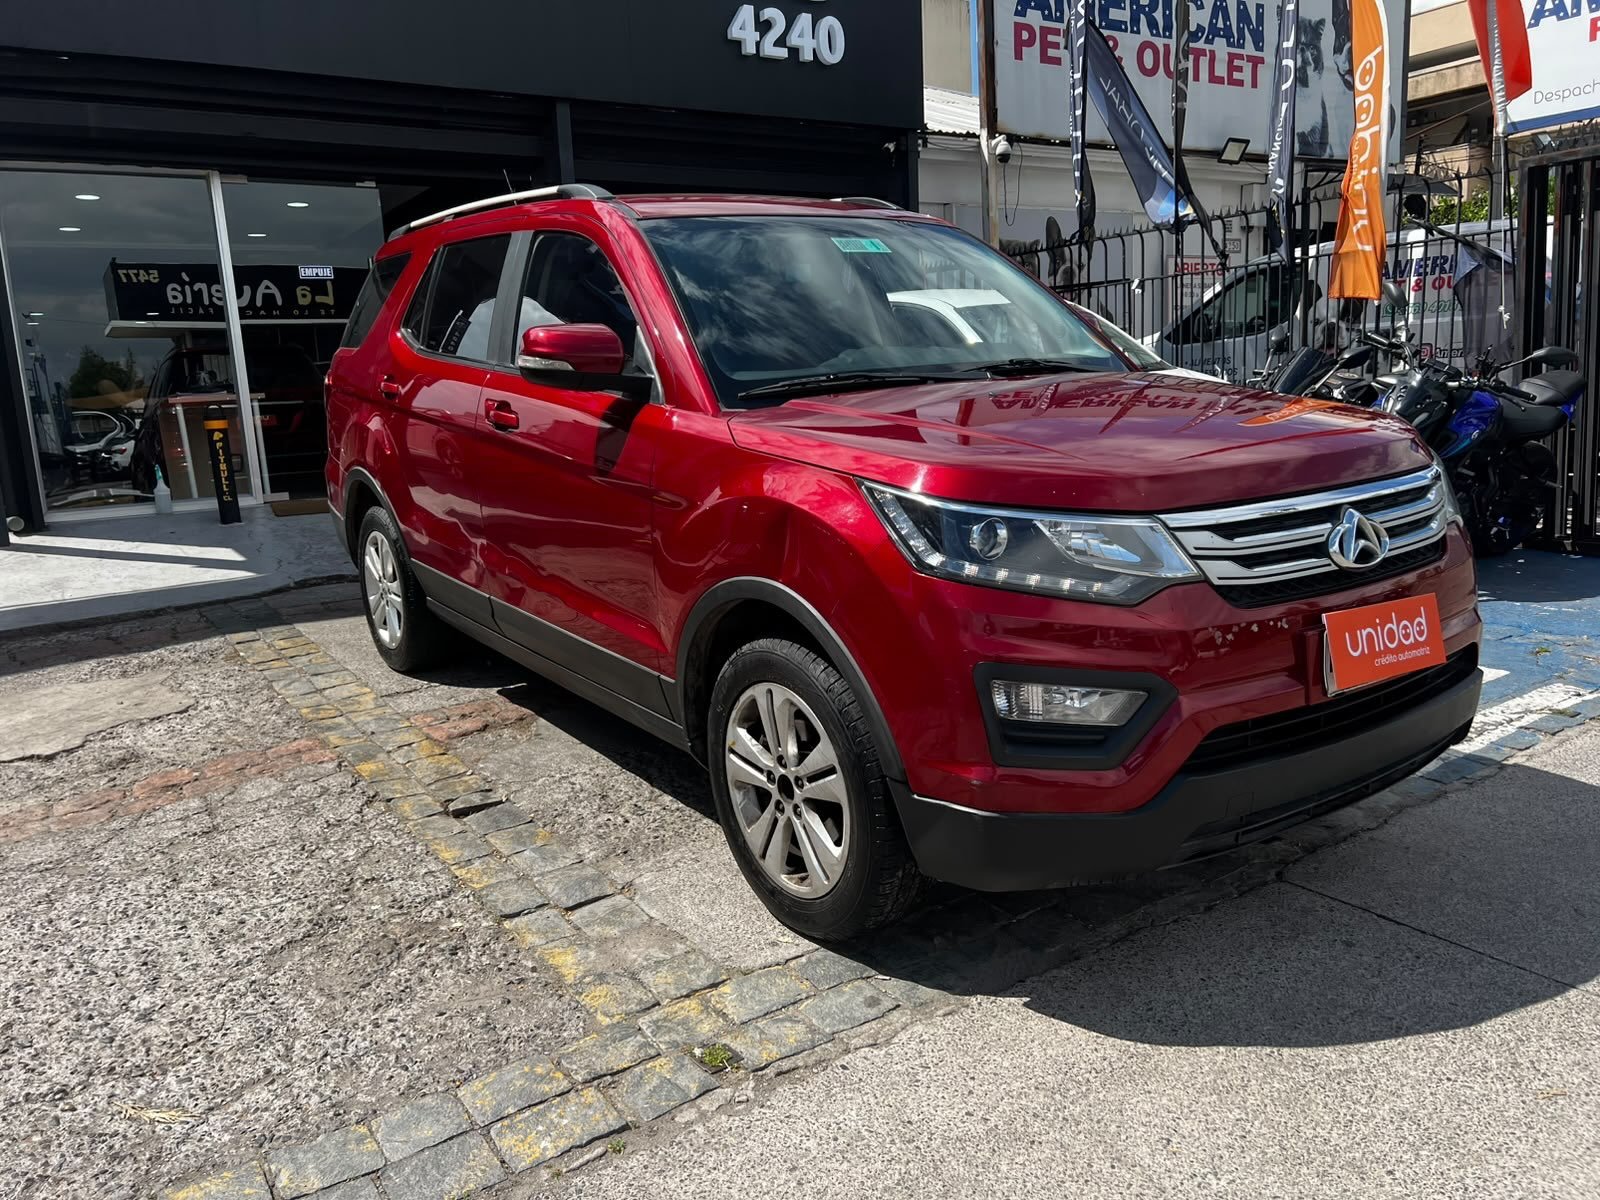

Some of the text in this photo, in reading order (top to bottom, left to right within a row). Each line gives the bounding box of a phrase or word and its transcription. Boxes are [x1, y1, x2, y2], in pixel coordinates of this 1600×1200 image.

[727, 4, 845, 65] 4240
[1013, 0, 1265, 52] ERICAN
[1013, 21, 1066, 66] PE
[1137, 40, 1265, 89] OUTLET
[301, 267, 331, 277] EMPUJE
[1345, 606, 1428, 657] unidad
[1374, 654, 1398, 667] crédito
